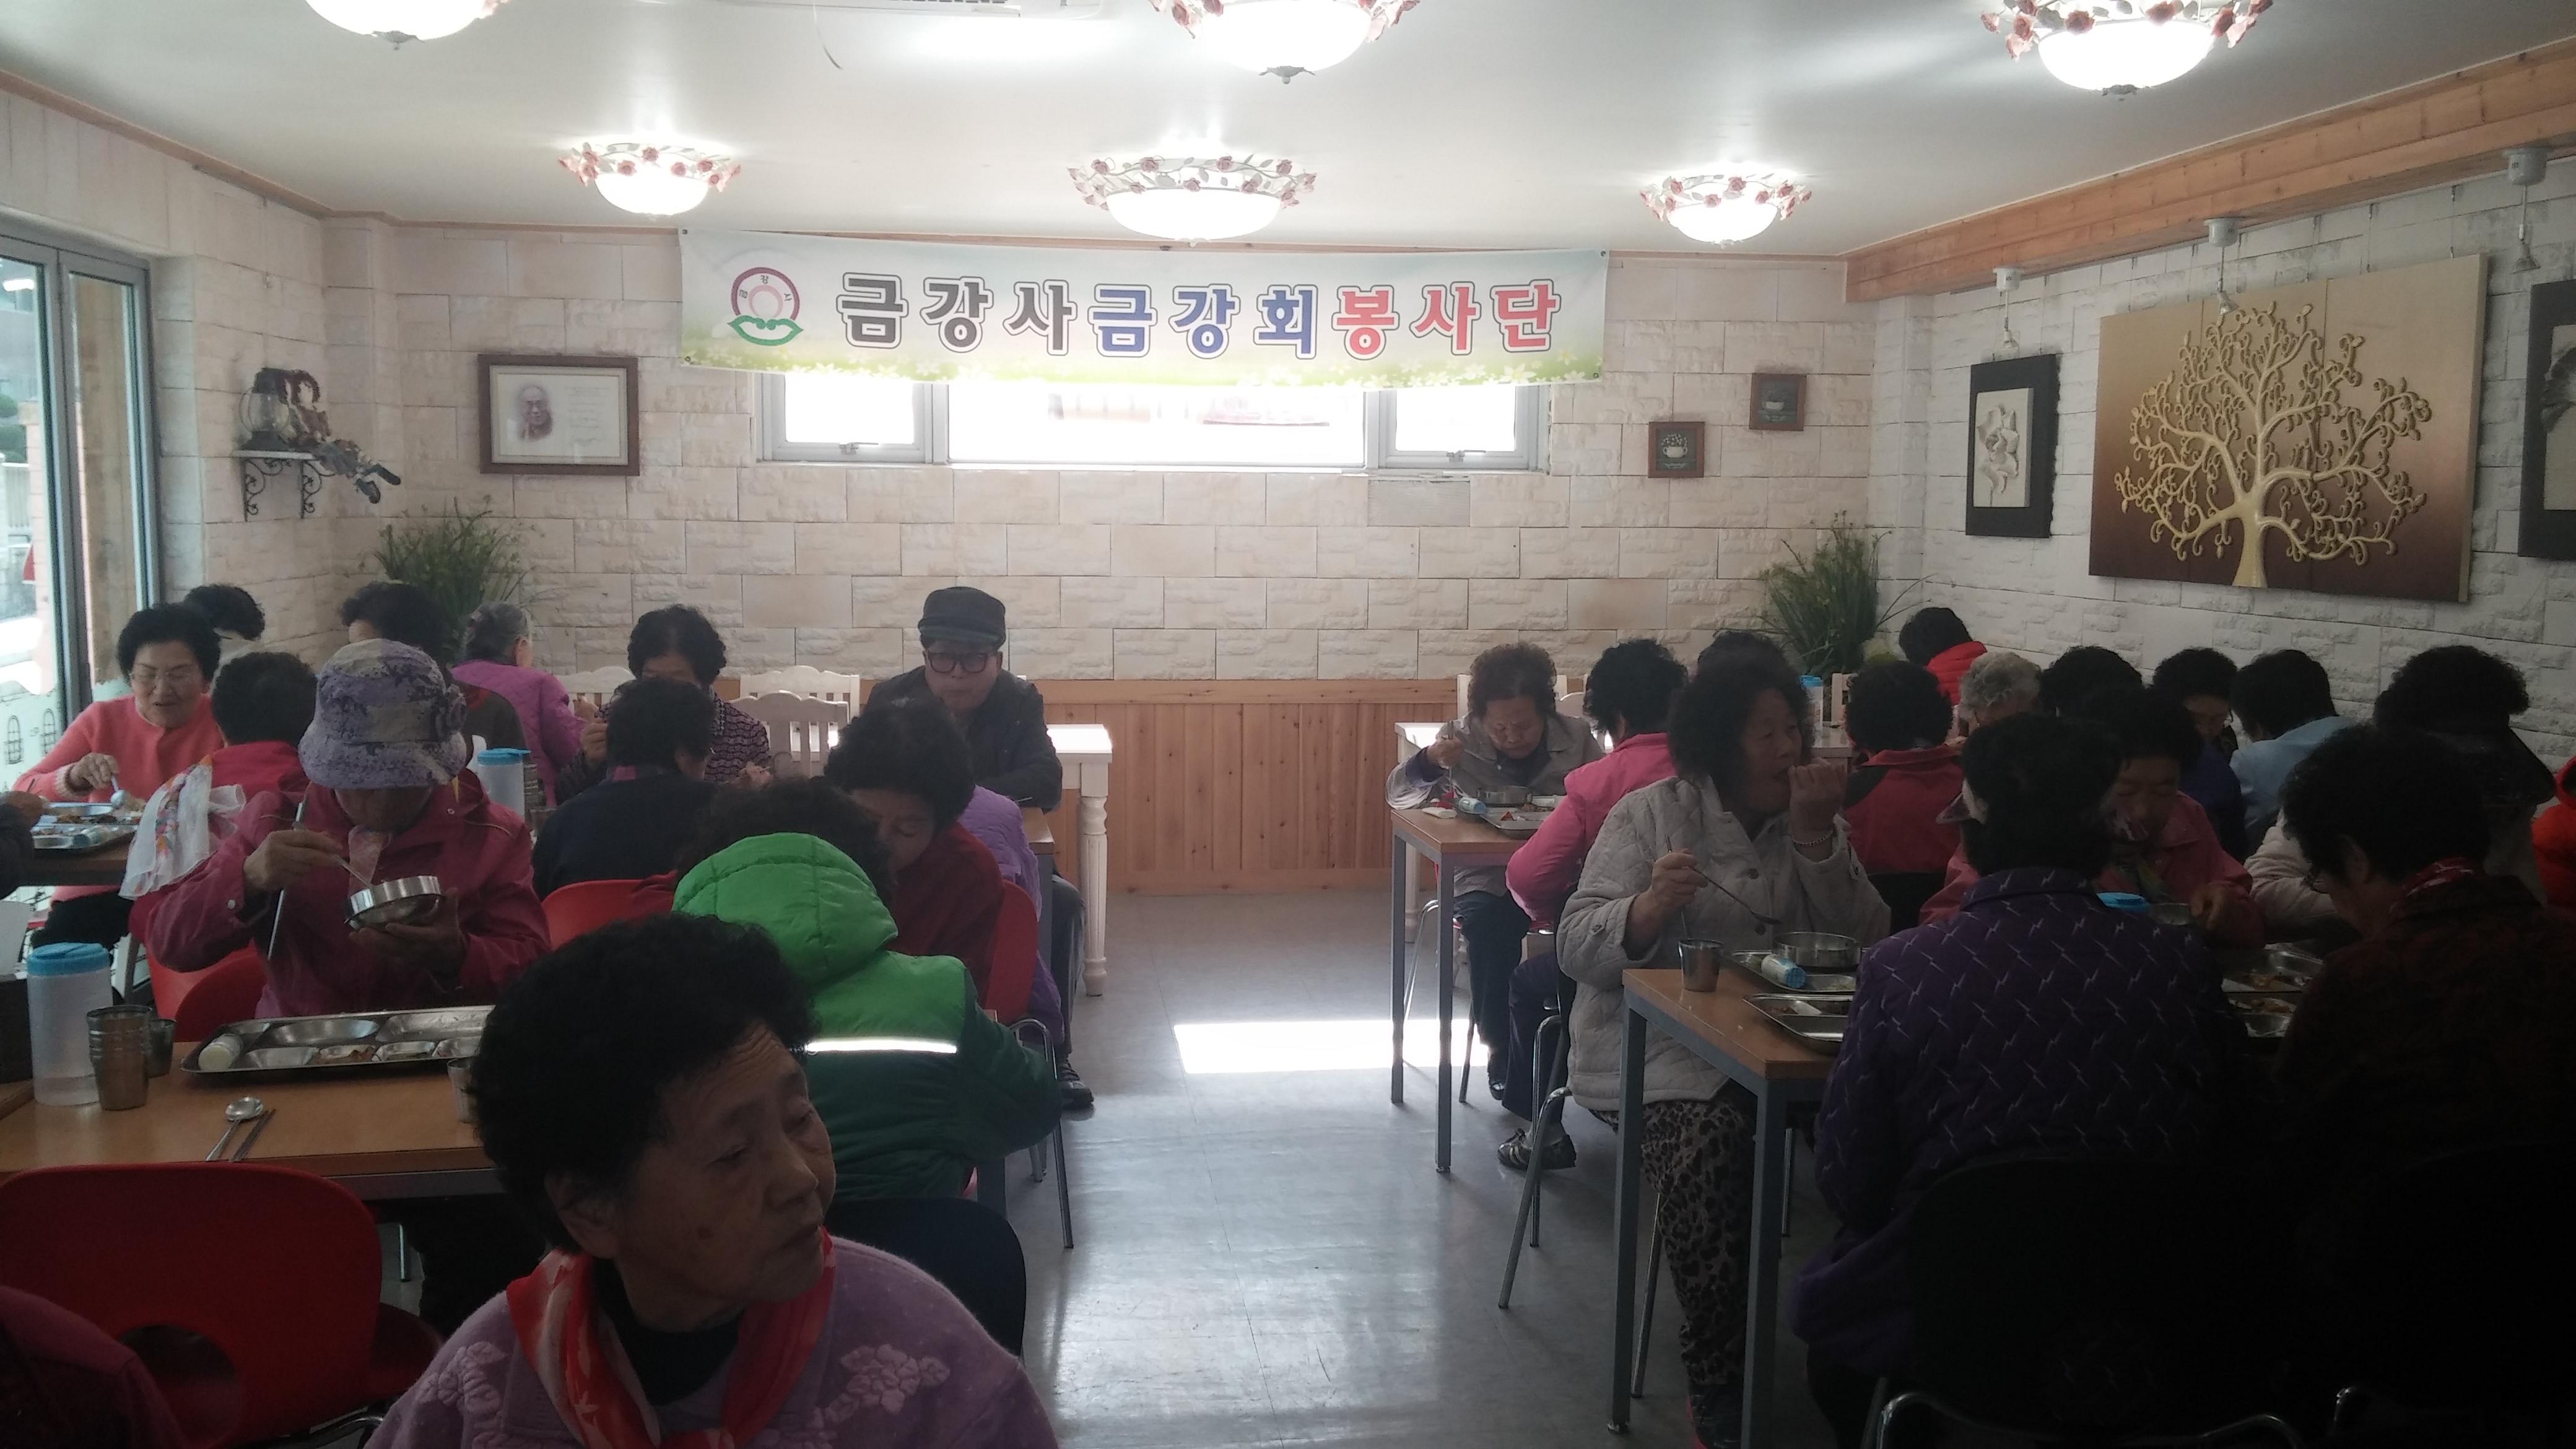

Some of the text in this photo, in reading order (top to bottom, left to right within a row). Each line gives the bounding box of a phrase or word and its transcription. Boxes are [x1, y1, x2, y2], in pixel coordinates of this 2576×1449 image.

[739, 275, 793, 302] 금강사
[836, 272, 1561, 360] 금강사 금강회 봉사단
